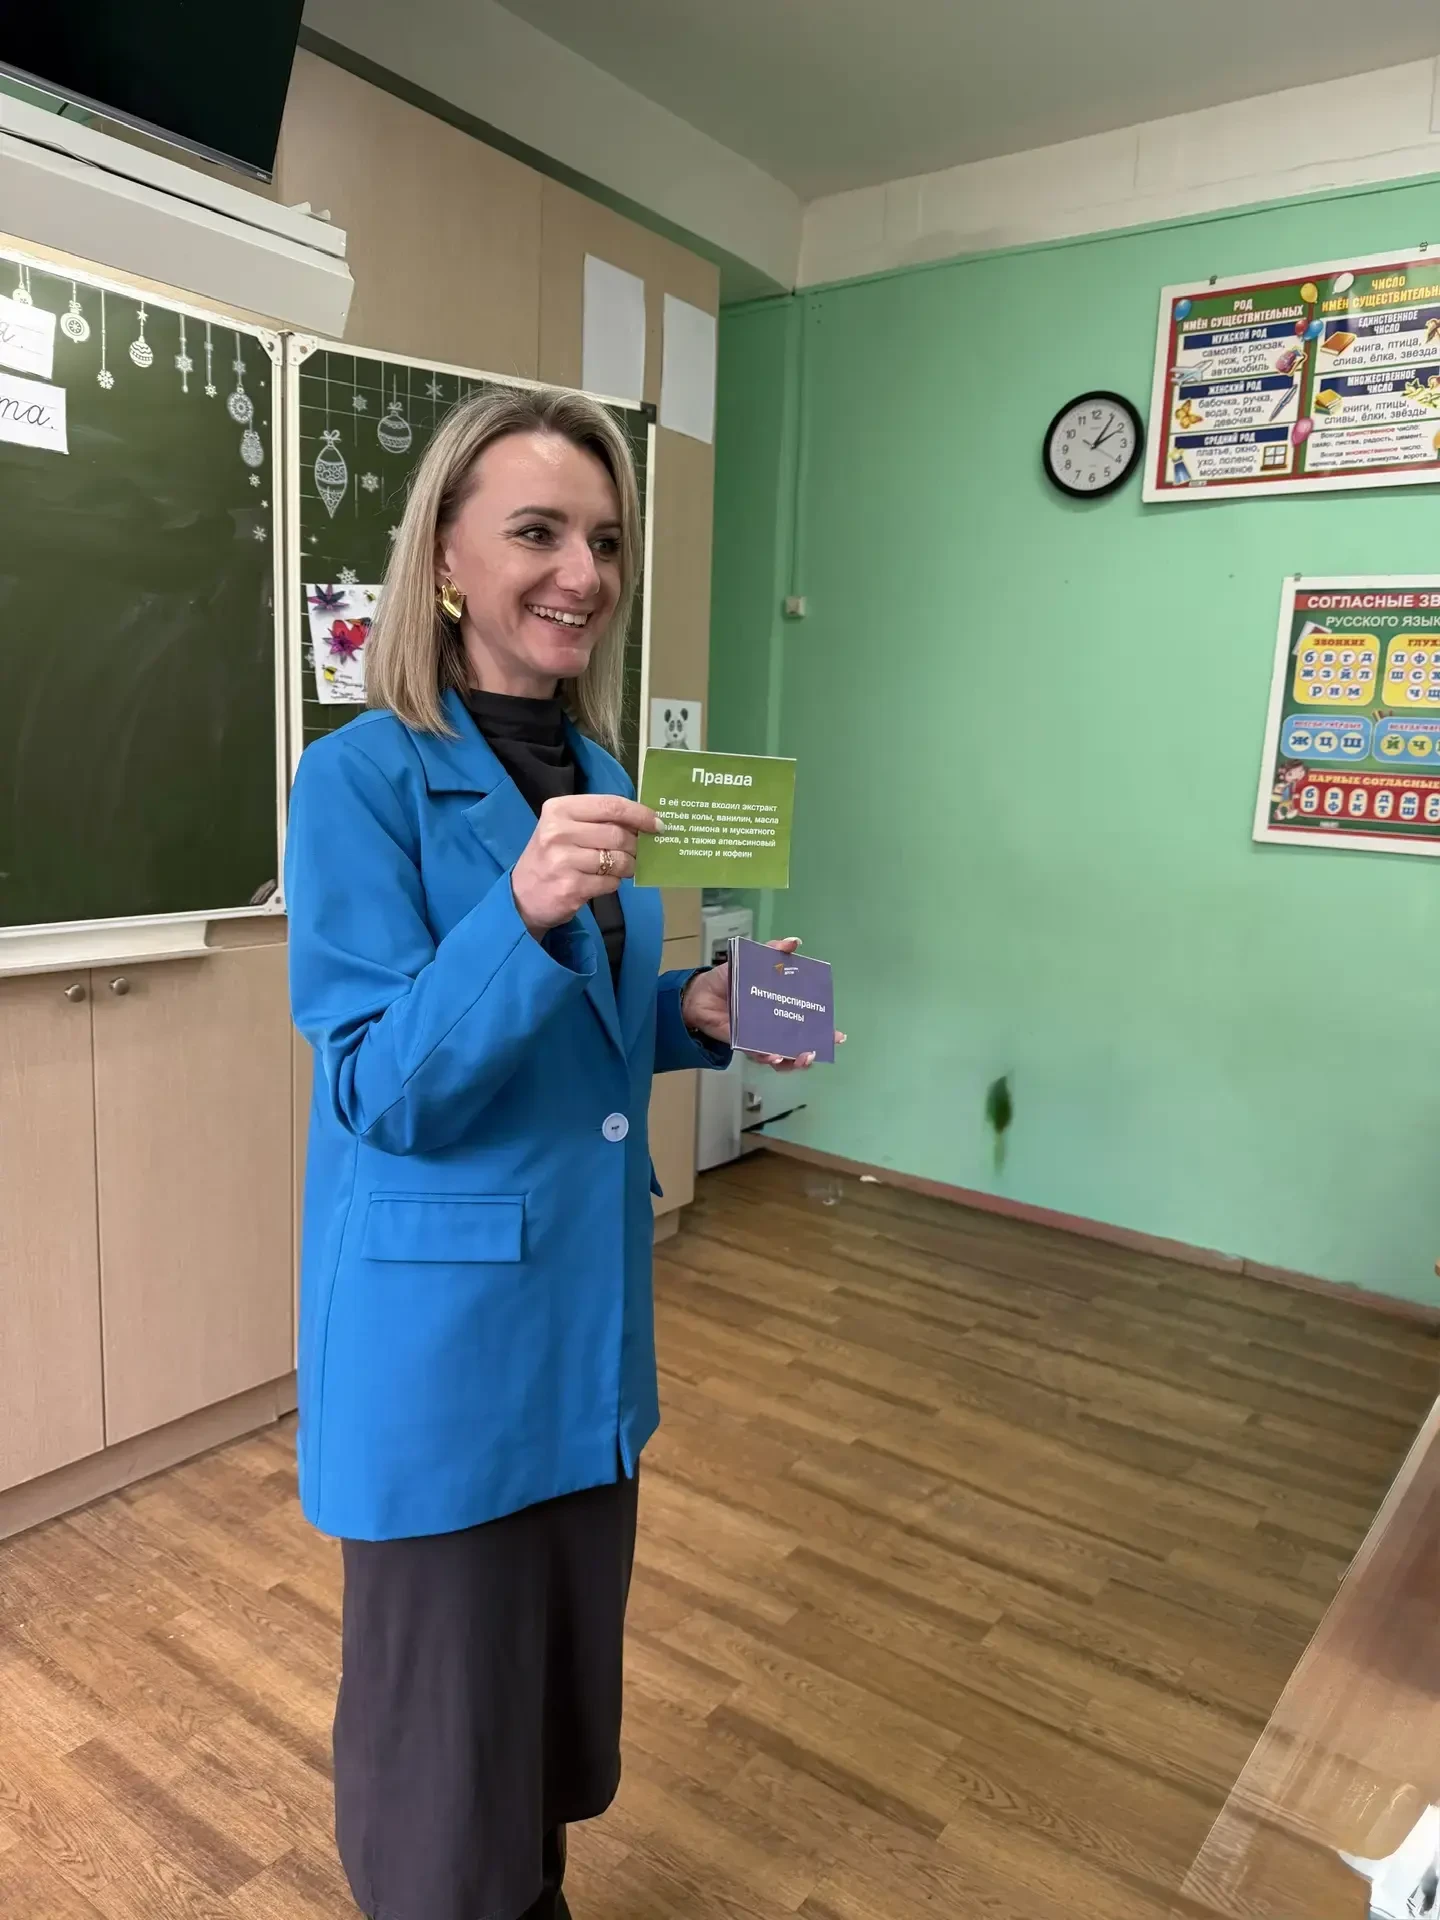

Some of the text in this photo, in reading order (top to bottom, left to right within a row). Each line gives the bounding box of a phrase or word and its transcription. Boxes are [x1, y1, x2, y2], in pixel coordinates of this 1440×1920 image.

[1372, 275, 1406, 290] ЧИСЛО
[1322, 285, 1440, 312] ИМЁН СУЩЕСТВИТЕЛЬН
[1233, 299, 1253, 311] РОД
[1183, 304, 1304, 331] ИМЁН СУЩЕСТВИТЕЛЬНЫХ
[1358, 310, 1418, 327] ЕДИНСТВЕННОЕ
[1373, 323, 1400, 334] ЧИСЛО
[1212, 328, 1267, 344] МУЖСКОЙ РОД
[1202, 340, 1285, 358] самолёт, рюкзак,
[1353, 338, 1422, 353] книга, птица,
[1218, 353, 1267, 366] нож, стул,
[1333, 347, 1437, 366] слива, ёлка, звезда
[1211, 363, 1269, 377] автомобиль
[1347, 369, 1416, 386] МНОЖЕСТВЕННОЕ
[1208, 380, 1262, 395] ЖЕНСКИЙ РОД
[1367, 383, 1393, 393] ЧИСЛО
[1198, 394, 1273, 409] бабочка, ручка,
[1343, 400, 1409, 414] книги, птицы,
[1091, 410, 1102, 420] 12
[1205, 405, 1264, 418] вода, сумка,
[1324, 408, 1427, 425] сливы, ёлки, звёзды
[1078, 416, 1086, 425] 11
[1213, 416, 1253, 428] девочка
[1117, 422, 1124, 433] 2
[1066, 429, 1076, 439] 10
[1204, 432, 1255, 446] СРЕДНИЙ РОД
[1062, 444, 1069, 454] 9
[1120, 438, 1127, 448] 3
[1196, 444, 1260, 457] платье, окно,
[1064, 459, 1072, 470] 8
[1114, 454, 1122, 464] 4
[1075, 469, 1082, 479] 7
[1104, 466, 1111, 477] 5
[1199, 465, 1253, 477] мороженое
[1088, 472, 1096, 483] 6
[1307, 595, 1414, 609] СОГЛАСНЫЕ
[1325, 616, 1399, 627] РУССКОГО
[1313, 638, 1366, 647] ЗВОНКИЕ
[1305, 652, 1372, 663] б в г д
[1394, 654, 1405, 662] п
[1414, 654, 1425, 664] ф
[1302, 669, 1370, 678] ж з й л
[1391, 671, 1404, 679] ш
[1412, 671, 1422, 679] с
[1312, 686, 1322, 696] р
[1329, 687, 1339, 695] н
[1410, 689, 1420, 697] ч
[1291, 737, 1362, 748] ж ц ш
[1387, 736, 1426, 750] й ч
[691, 767, 753, 787] Правда
[1308, 774, 1440, 789] ПАРНЫЕ СОГЛАСНЫЕ
[1305, 788, 1315, 797] б
[1379, 795, 1389, 803] д
[659, 797, 666, 805] В
[681, 800, 709, 808] состав
[711, 802, 740, 810] входил
[742, 803, 777, 812] экстракт
[1328, 802, 1339, 811] ф
[1352, 803, 1362, 811] к
[1379, 805, 1388, 813] т
[1402, 807, 1415, 815] ш
[1429, 809, 1440, 817] с
[691, 813, 715, 821] колы,
[716, 814, 753, 823] ванилин,
[754, 816, 779, 824] масла
[663, 824, 686, 832] айма,
[688, 824, 720, 833] лимона
[729, 827, 775, 836] мускатного
[654, 836, 681, 844] ореха,
[691, 837, 716, 845] также
[718, 837, 776, 847] апельсиновый
[679, 848, 753, 859] эликсир и кофеин
[750, 985, 826, 1012] Антиперспиранты
[773, 1008, 805, 1022] опасны
